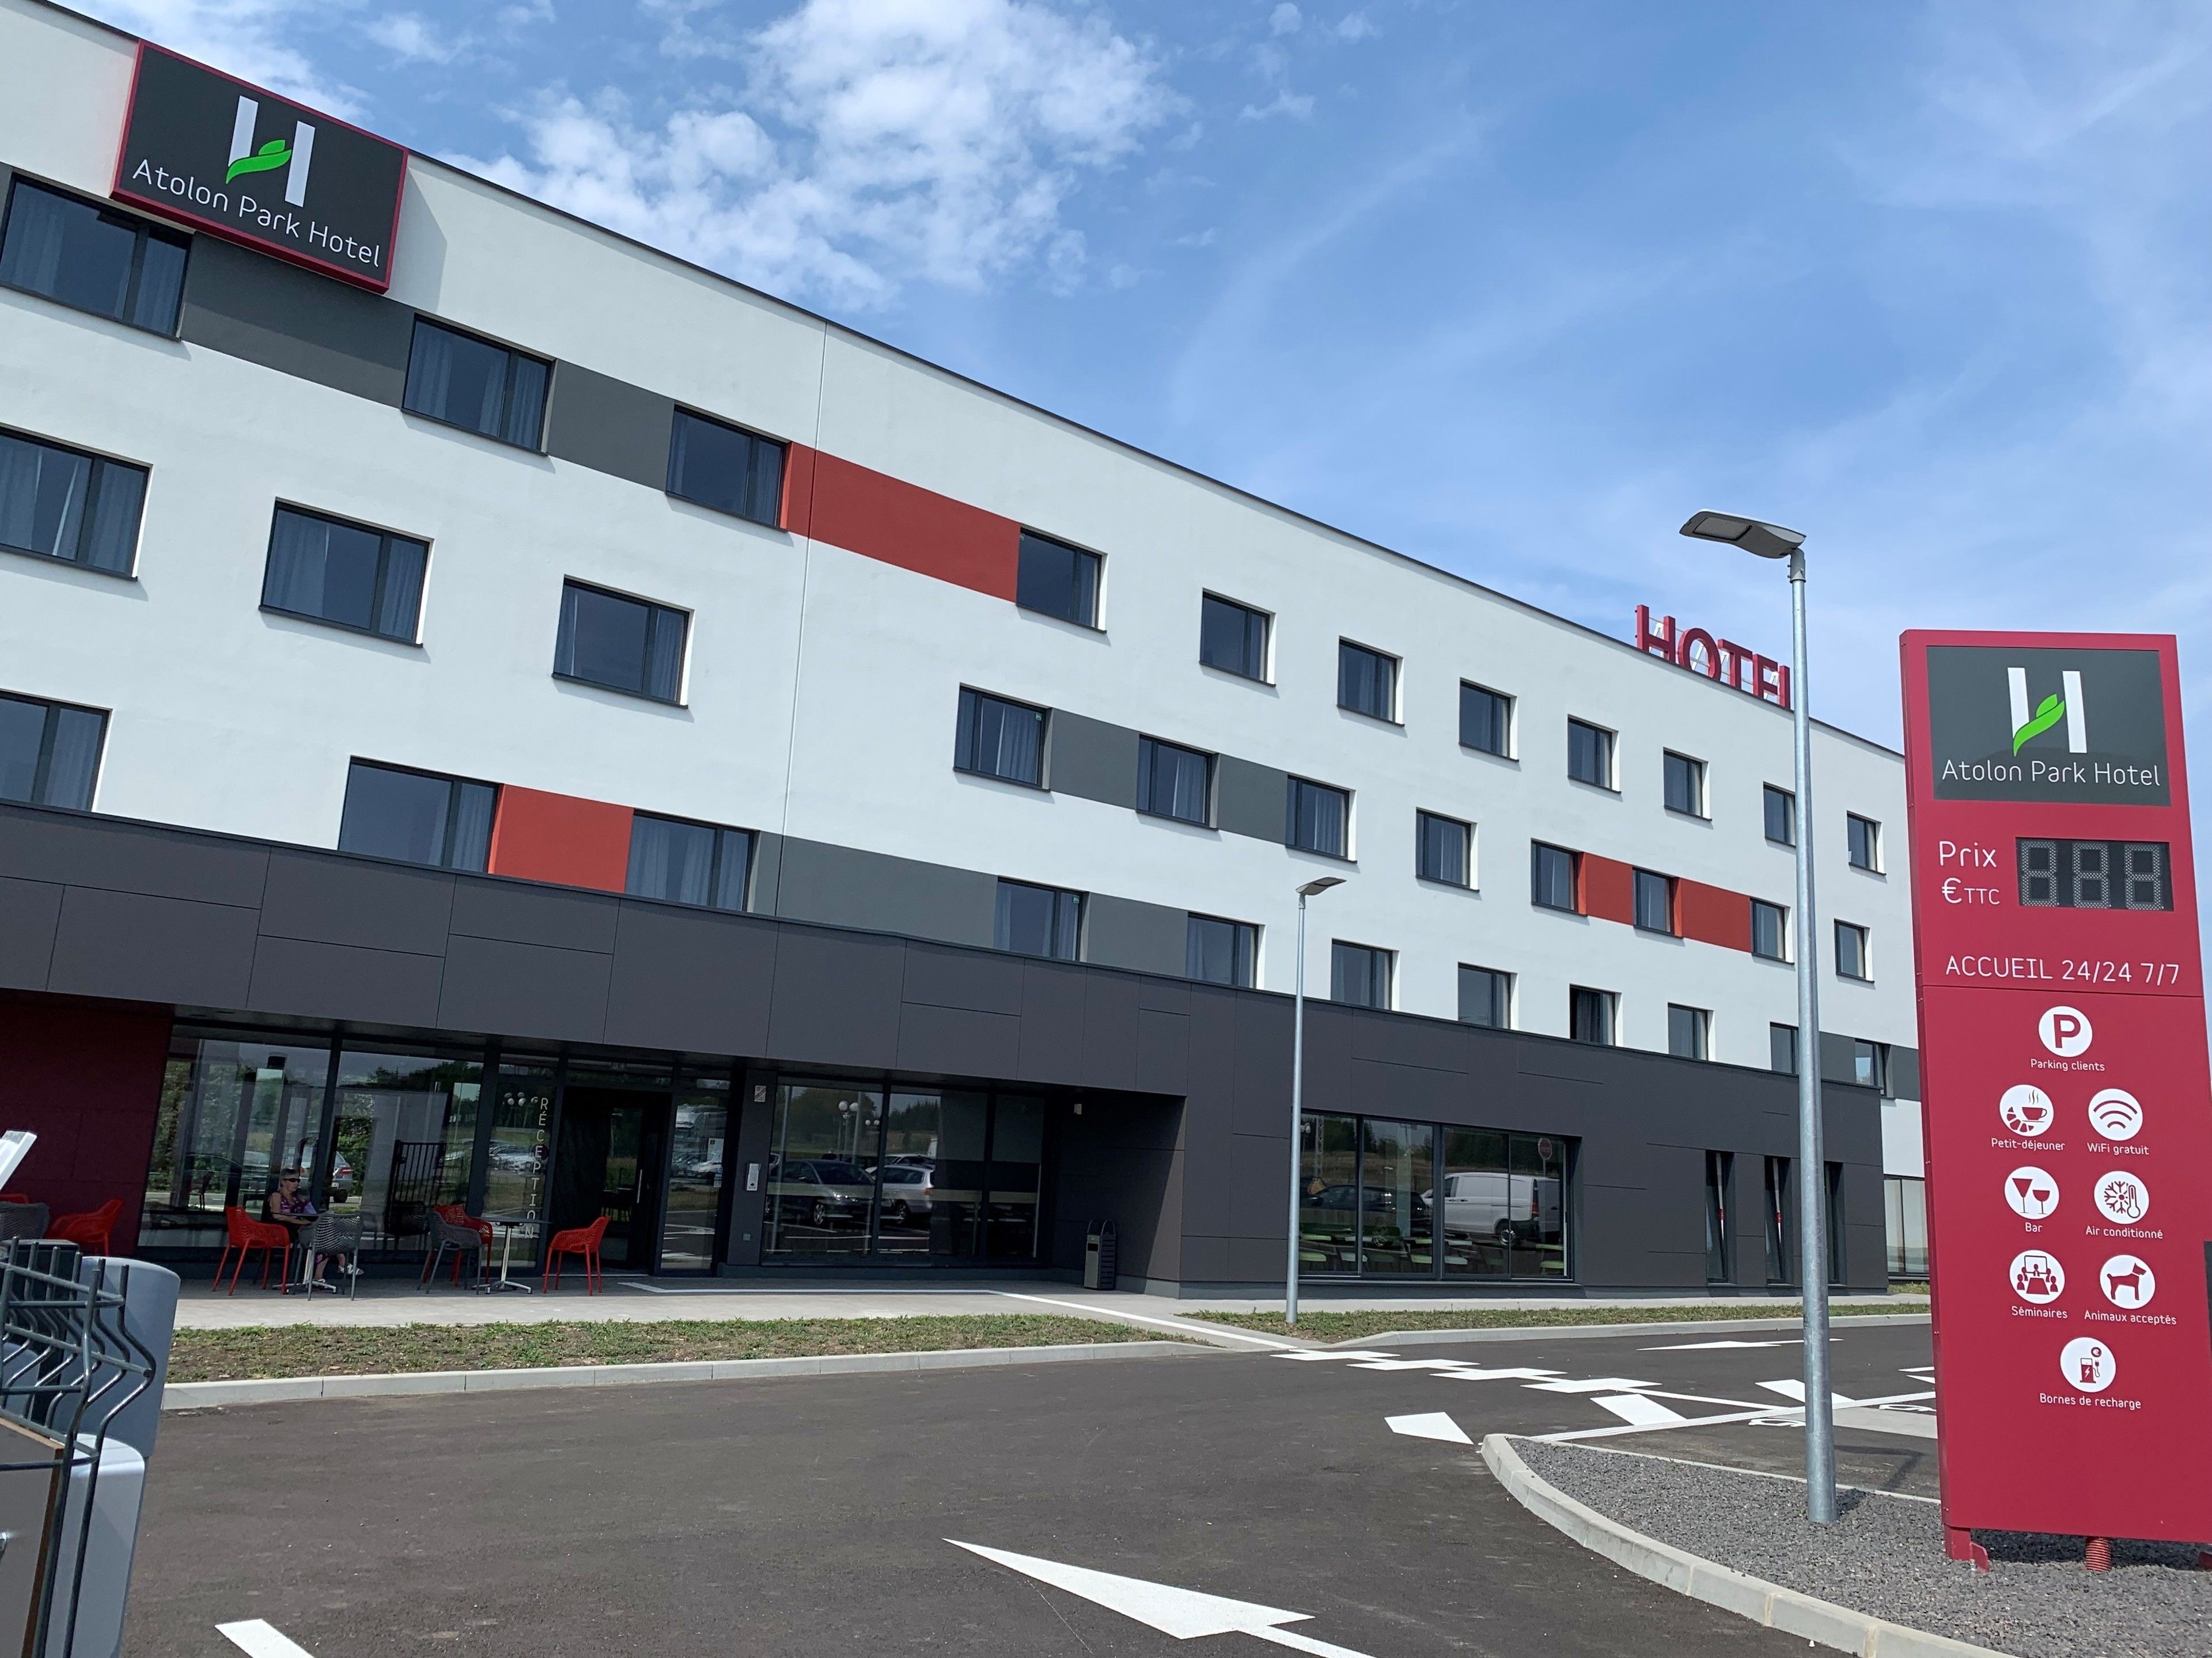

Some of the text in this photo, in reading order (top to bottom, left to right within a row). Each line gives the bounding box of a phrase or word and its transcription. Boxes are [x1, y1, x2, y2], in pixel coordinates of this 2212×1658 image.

[132, 159, 380, 267] Atolon Park Hotel
[1942, 759, 2161, 786] Atolon Park Hotel
[1939, 841, 1997, 868] Prix
[1945, 955, 2179, 986] ACCUEIL 24/24 7/7
[2031, 1058, 2105, 1072] Parking clients
[1991, 1137, 2066, 1152] Petit-déjeuner
[2086, 1142, 2149, 1155] WiFi gratuit
[2025, 1221, 2043, 1233] Bar
[2085, 1226, 2163, 1239] Air conditionné
[2011, 1306, 2069, 1319] Séminaires
[2084, 1310, 2177, 1326] Animaux acceptés
[2040, 1393, 2142, 1411] Bornes de recharge
